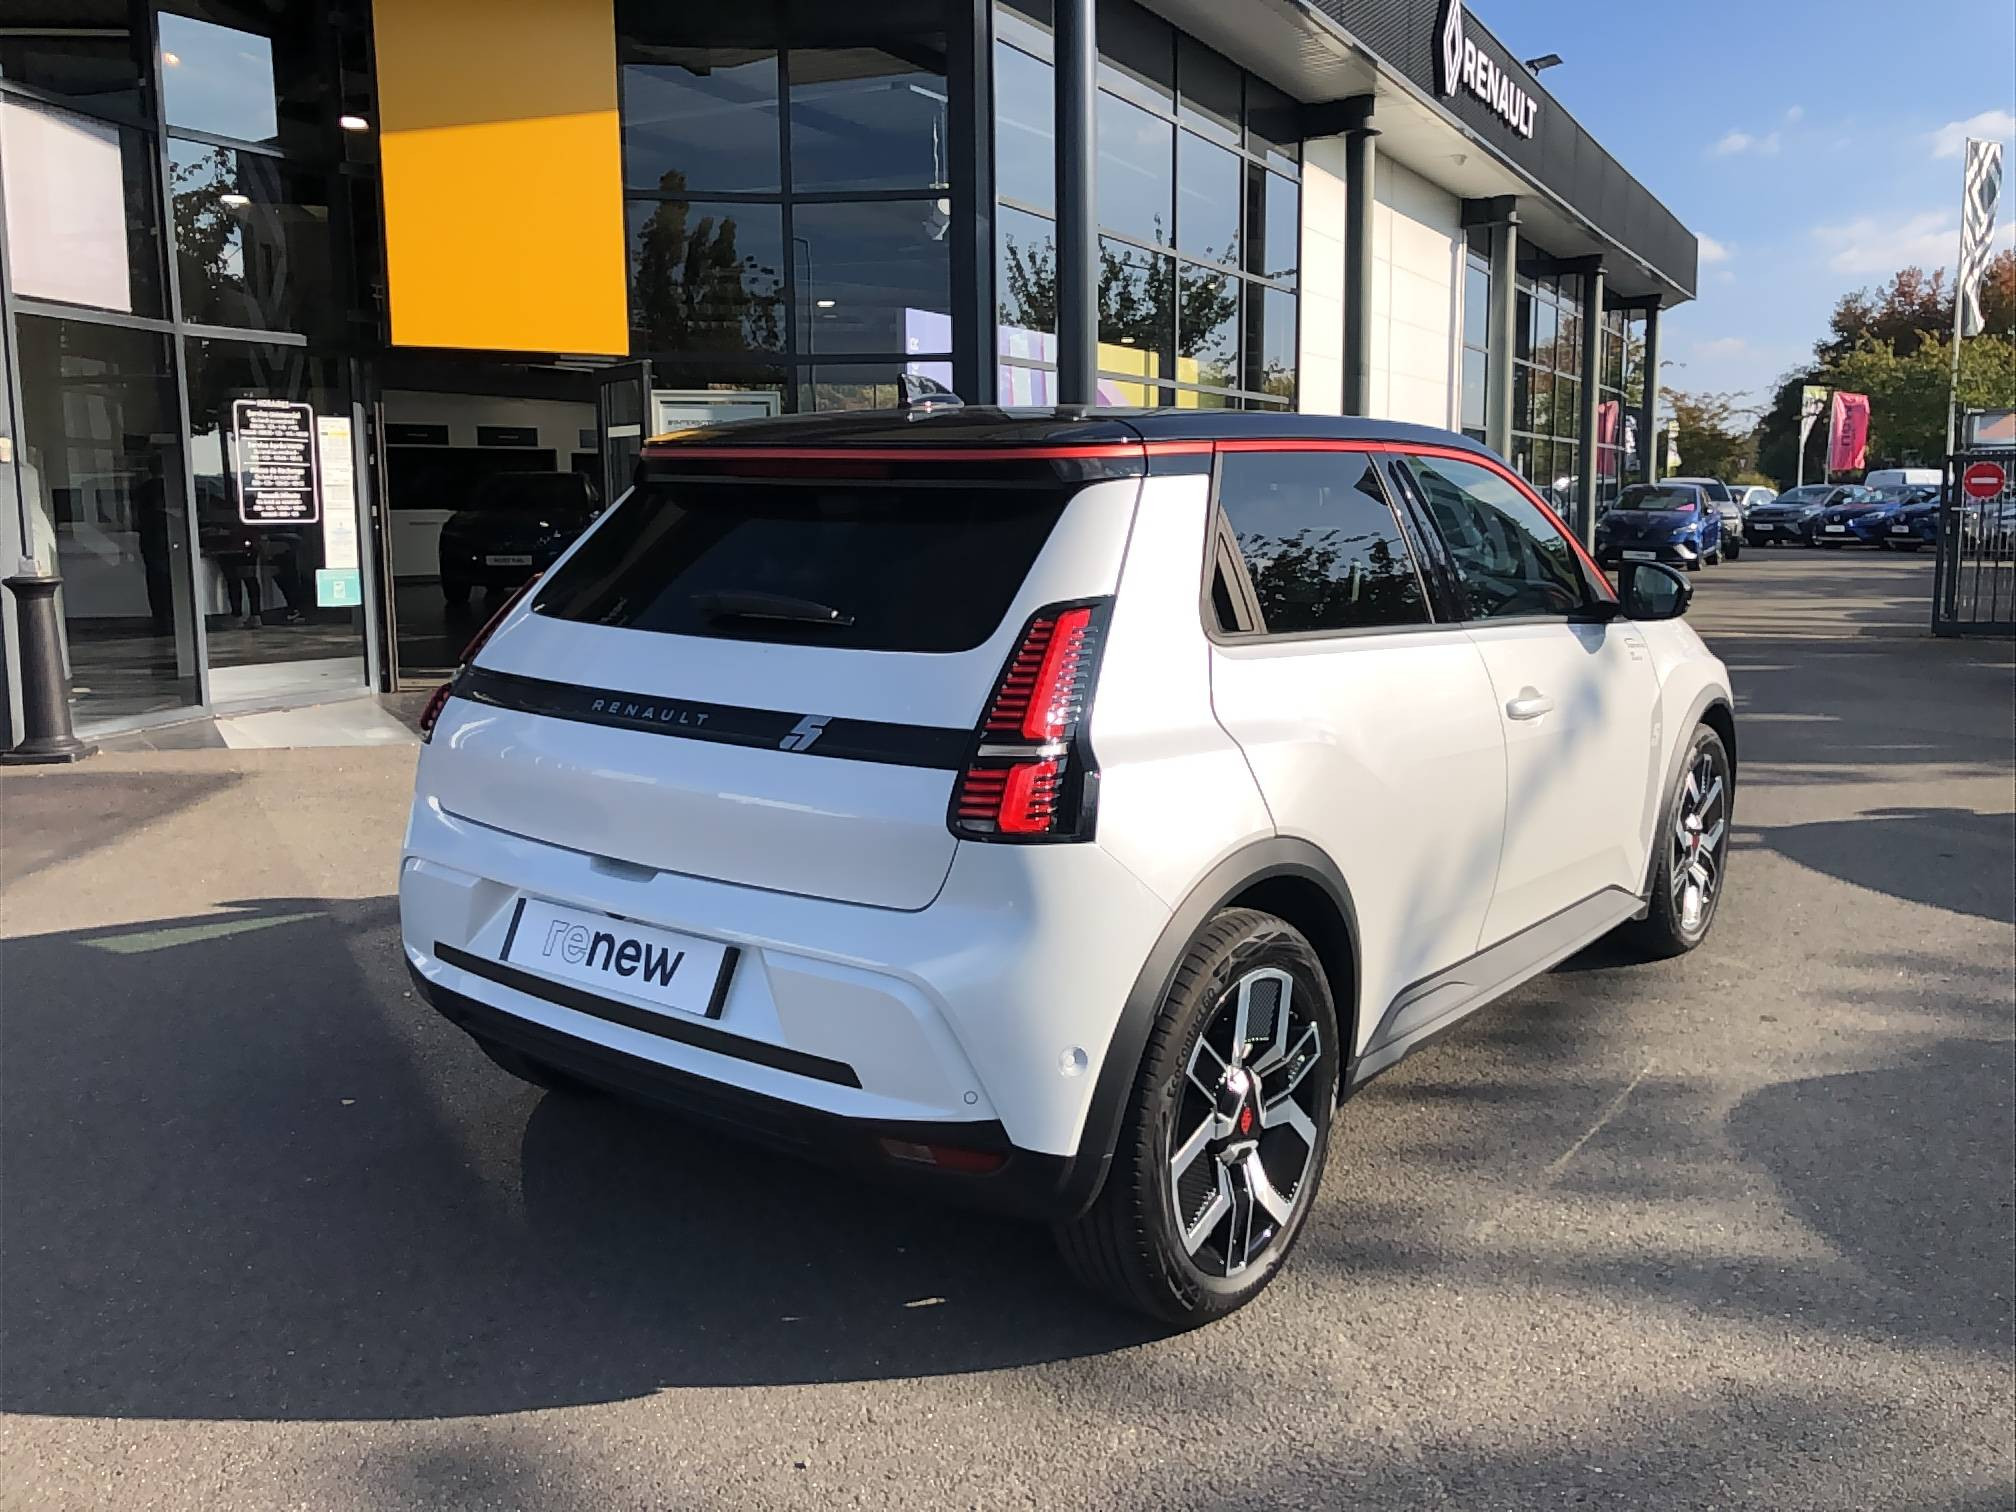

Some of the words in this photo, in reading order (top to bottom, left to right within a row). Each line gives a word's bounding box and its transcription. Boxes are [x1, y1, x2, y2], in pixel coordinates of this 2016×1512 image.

[1463, 36, 1538, 140] RENAULT
[591, 698, 709, 727] RENAULT
[779, 713, 833, 752] 5
[542, 918, 686, 988] renew
